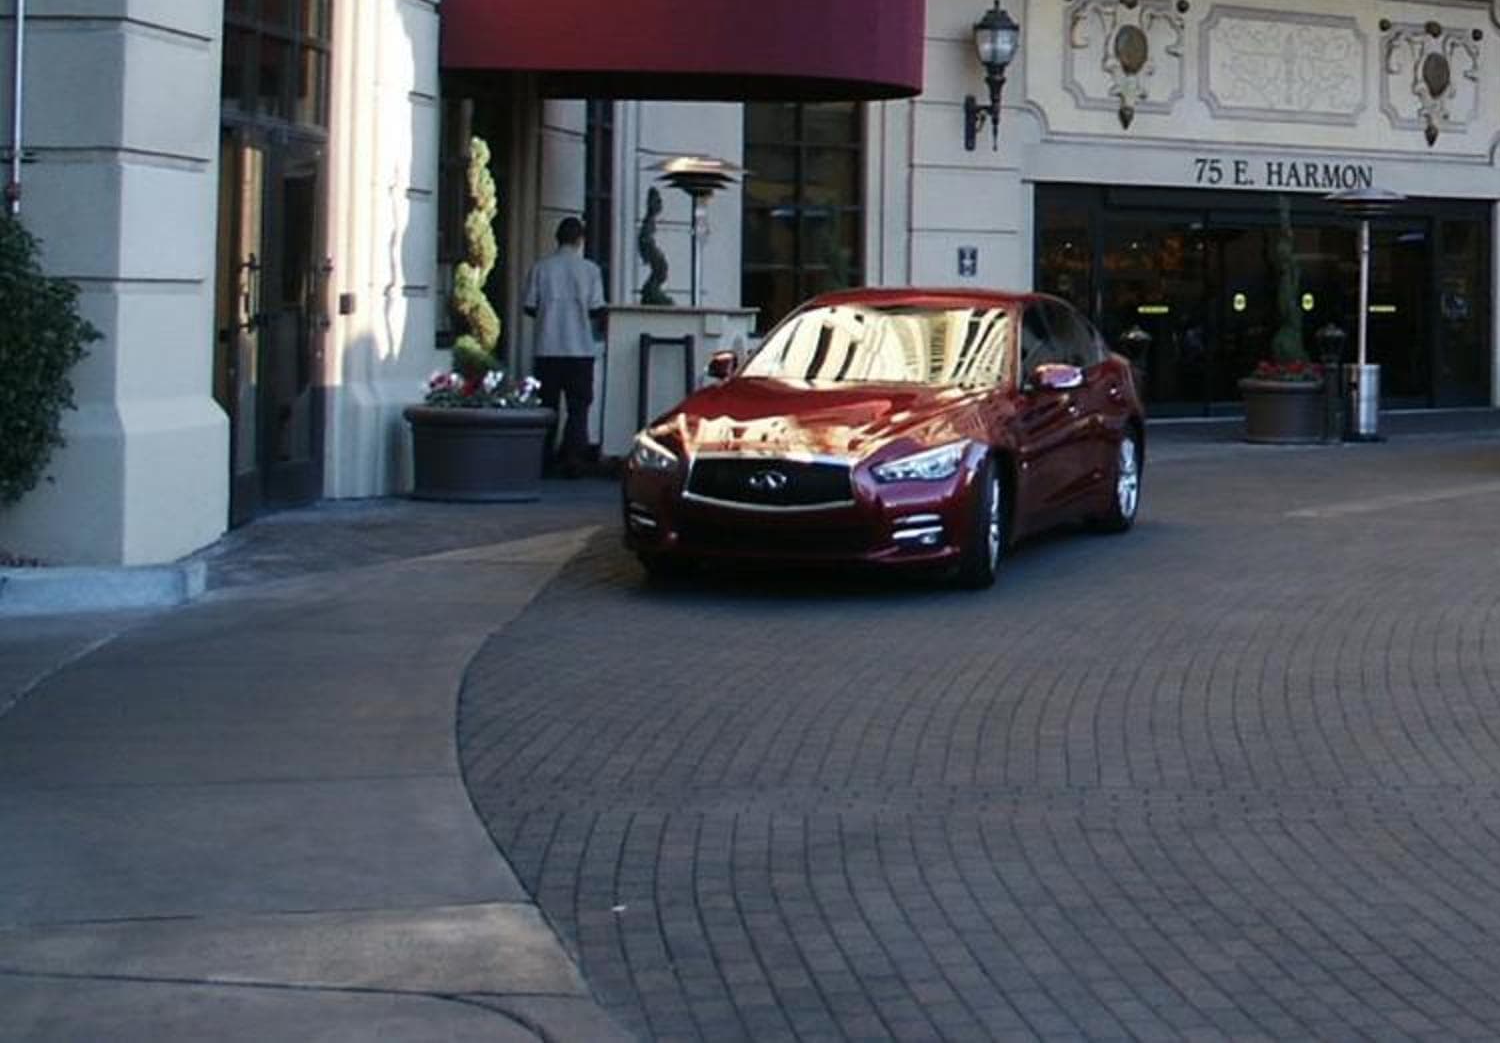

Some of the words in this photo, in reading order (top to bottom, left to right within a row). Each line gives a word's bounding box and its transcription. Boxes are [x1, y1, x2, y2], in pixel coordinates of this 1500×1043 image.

[1194, 158, 1223, 185] 75
[1234, 160, 1254, 186] E.
[1266, 161, 1373, 189] HARMON
